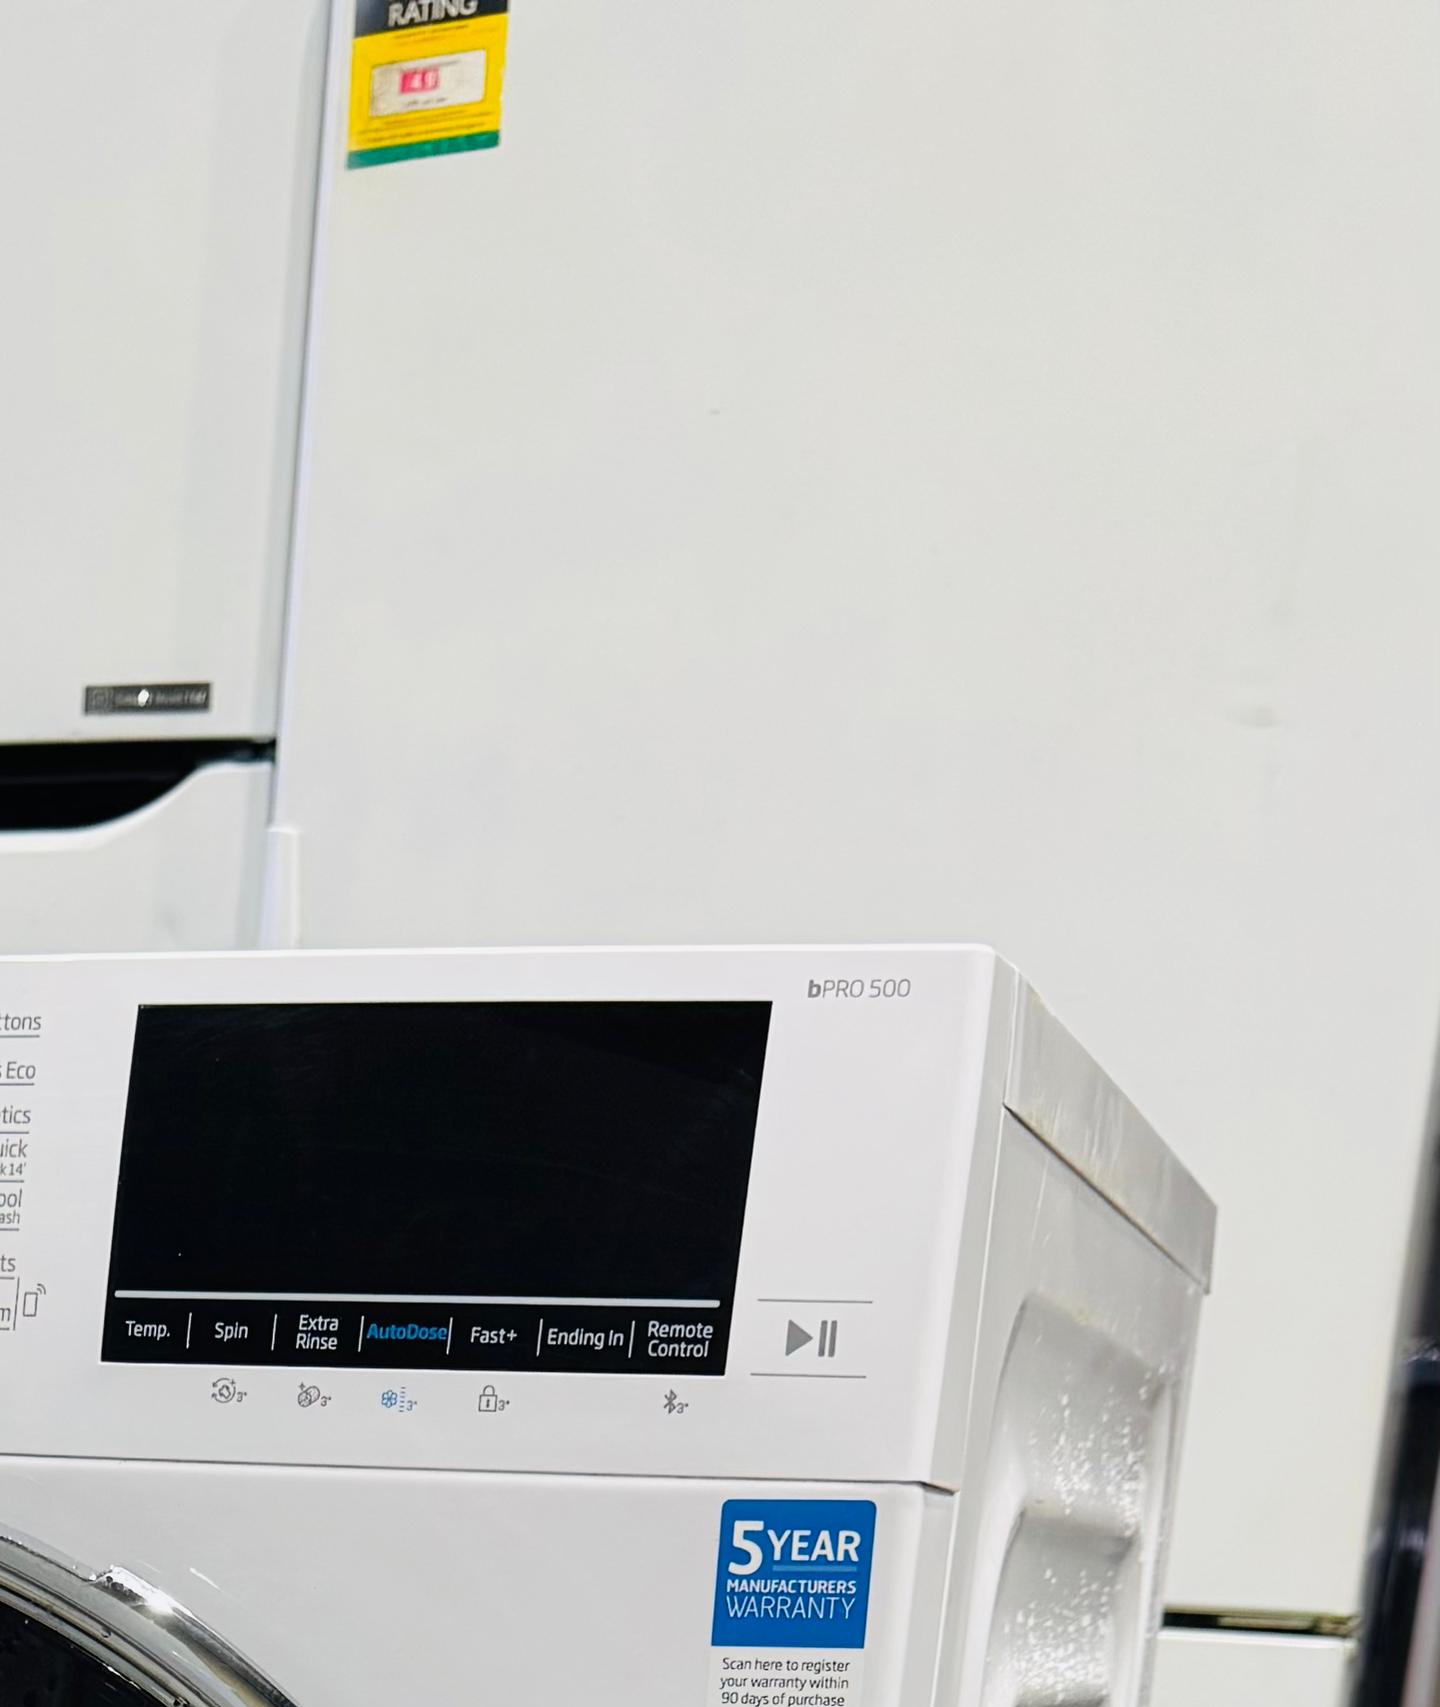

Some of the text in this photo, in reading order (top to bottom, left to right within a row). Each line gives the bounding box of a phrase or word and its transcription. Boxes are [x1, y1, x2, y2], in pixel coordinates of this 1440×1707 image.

[388, 0, 478, 27] RATING
[807, 978, 912, 998] bPRO 500
[6, 1062, 37, 1081] Eco
[125, 1320, 171, 1341] Temp.
[214, 1322, 249, 1342] Spin
[298, 1314, 340, 1332] Extra
[366, 1323, 447, 1341] AutoDose
[647, 1320, 714, 1339] Remote
[295, 1333, 338, 1350] Rinse
[470, 1326, 518, 1345] Fast+
[547, 1328, 625, 1350] Ending In
[647, 1340, 710, 1358] Control
[727, 1519, 862, 1576] 5 YEAR
[725, 1578, 857, 1595] MANUFACTURERS
[725, 1595, 857, 1620] WARRANTY
[722, 1657, 851, 1674] Scan here to register
[719, 1676, 849, 1691] your warranty within
[721, 1691, 845, 1707] 90 days of purchase
